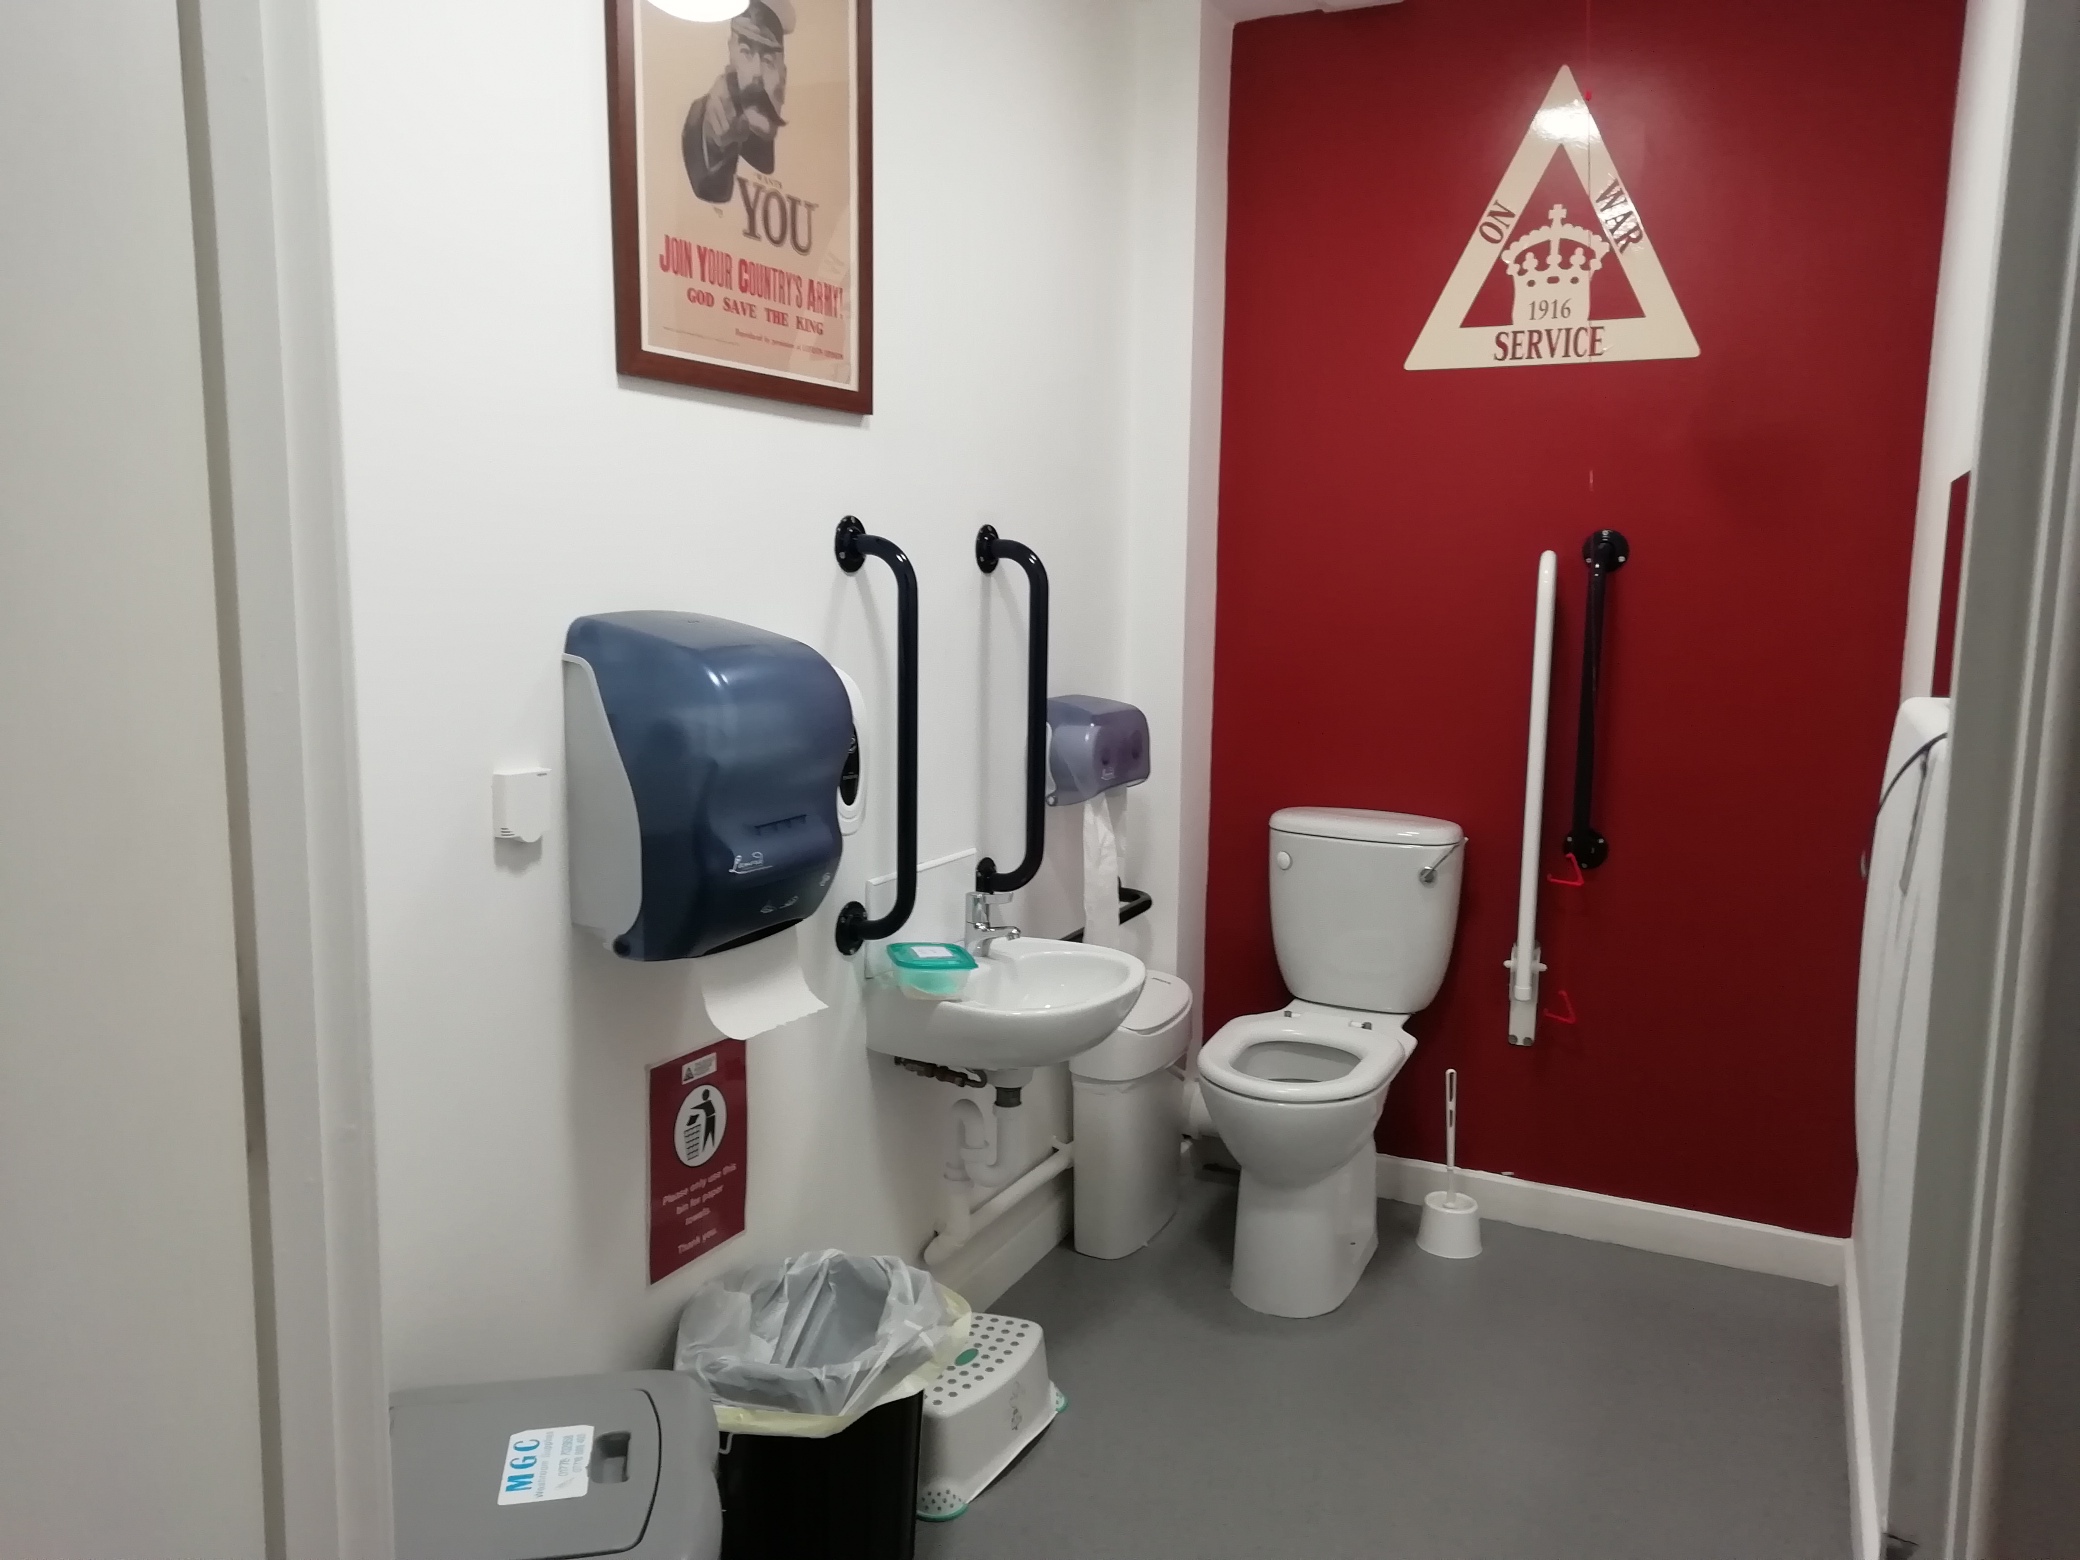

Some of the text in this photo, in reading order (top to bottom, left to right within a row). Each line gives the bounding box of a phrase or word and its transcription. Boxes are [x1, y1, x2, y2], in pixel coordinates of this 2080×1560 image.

[737, 176, 819, 256] YOU
[1478, 200, 1516, 244] ON
[1595, 178, 1644, 254] WAR
[659, 234, 844, 320] JOIN YOUR COUNTRY'S ARMY!
[687, 287, 824, 335] GOD SAVE THE KING
[1528, 298, 1571, 321] 1916
[1493, 325, 1605, 361] SERVICE
[505, 1438, 540, 1492] MGC
